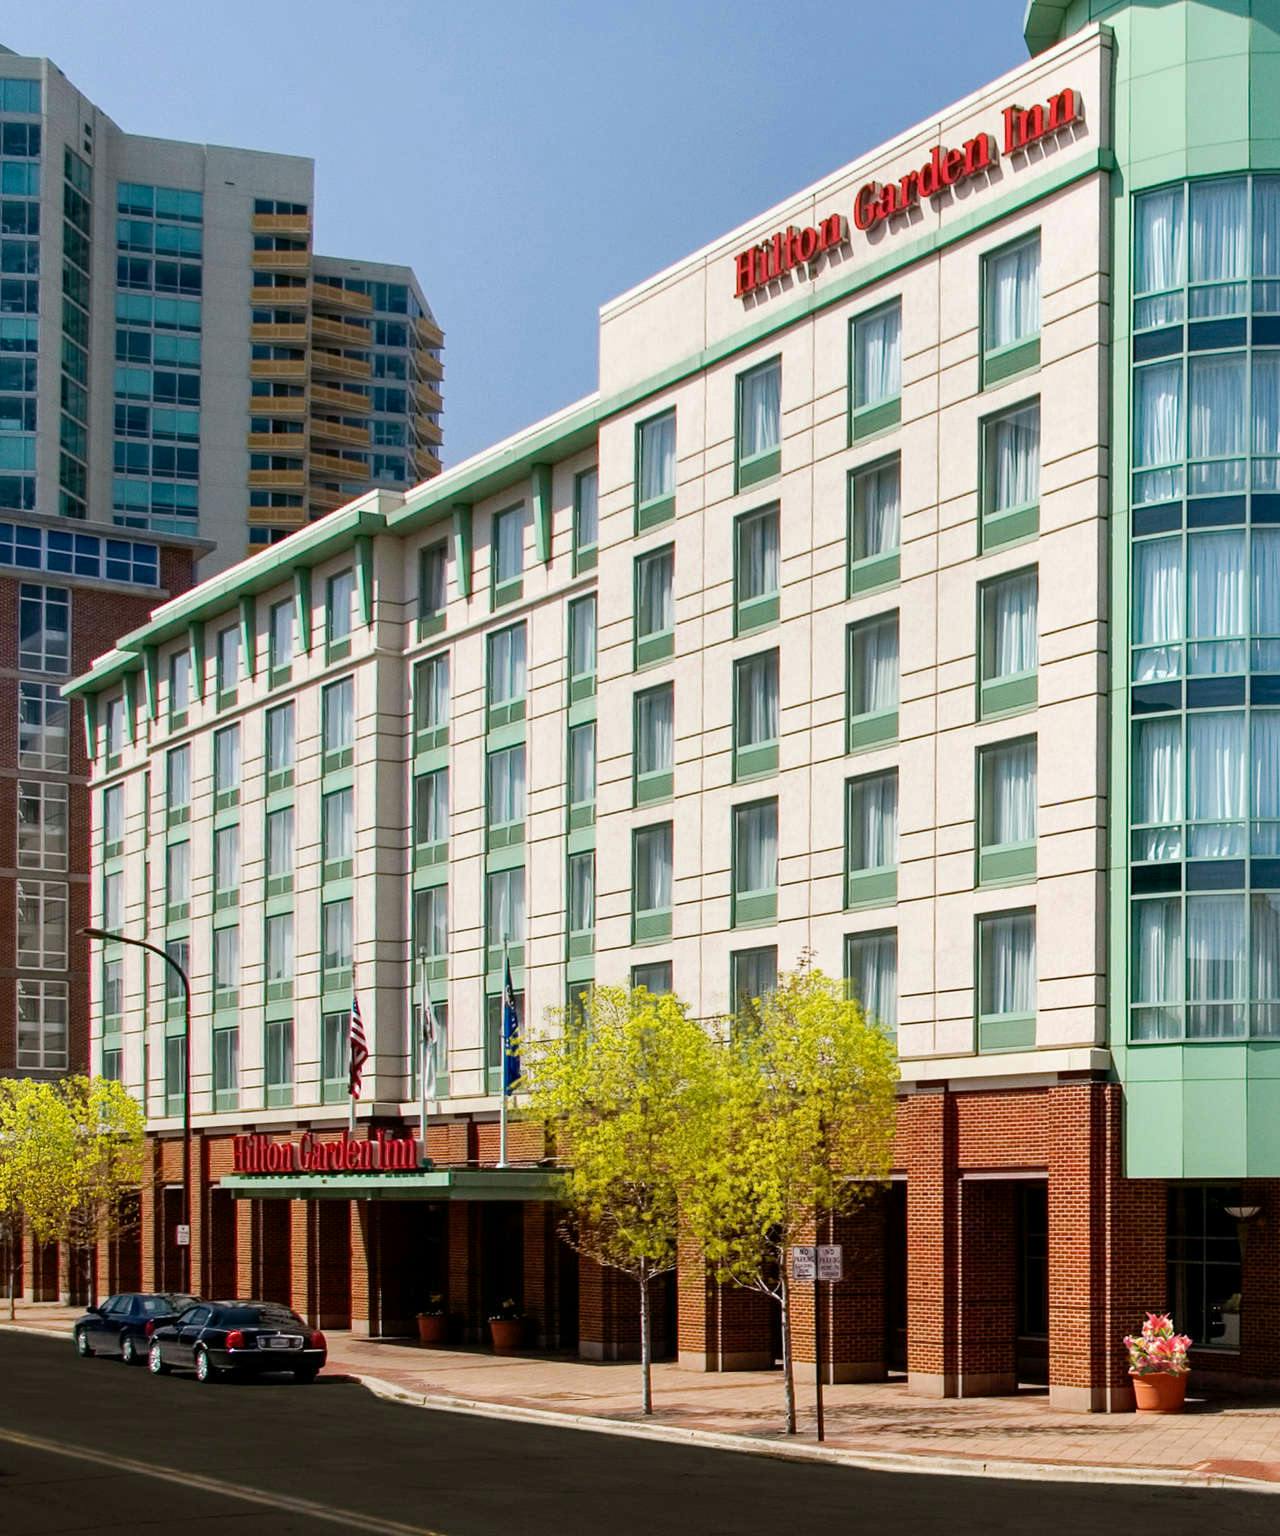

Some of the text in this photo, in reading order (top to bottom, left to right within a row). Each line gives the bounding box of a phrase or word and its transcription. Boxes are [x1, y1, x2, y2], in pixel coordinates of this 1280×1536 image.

[734, 88, 1081, 299] Hilton Garden Inn
[232, 1128, 418, 1172] Hilton Garden Inn
